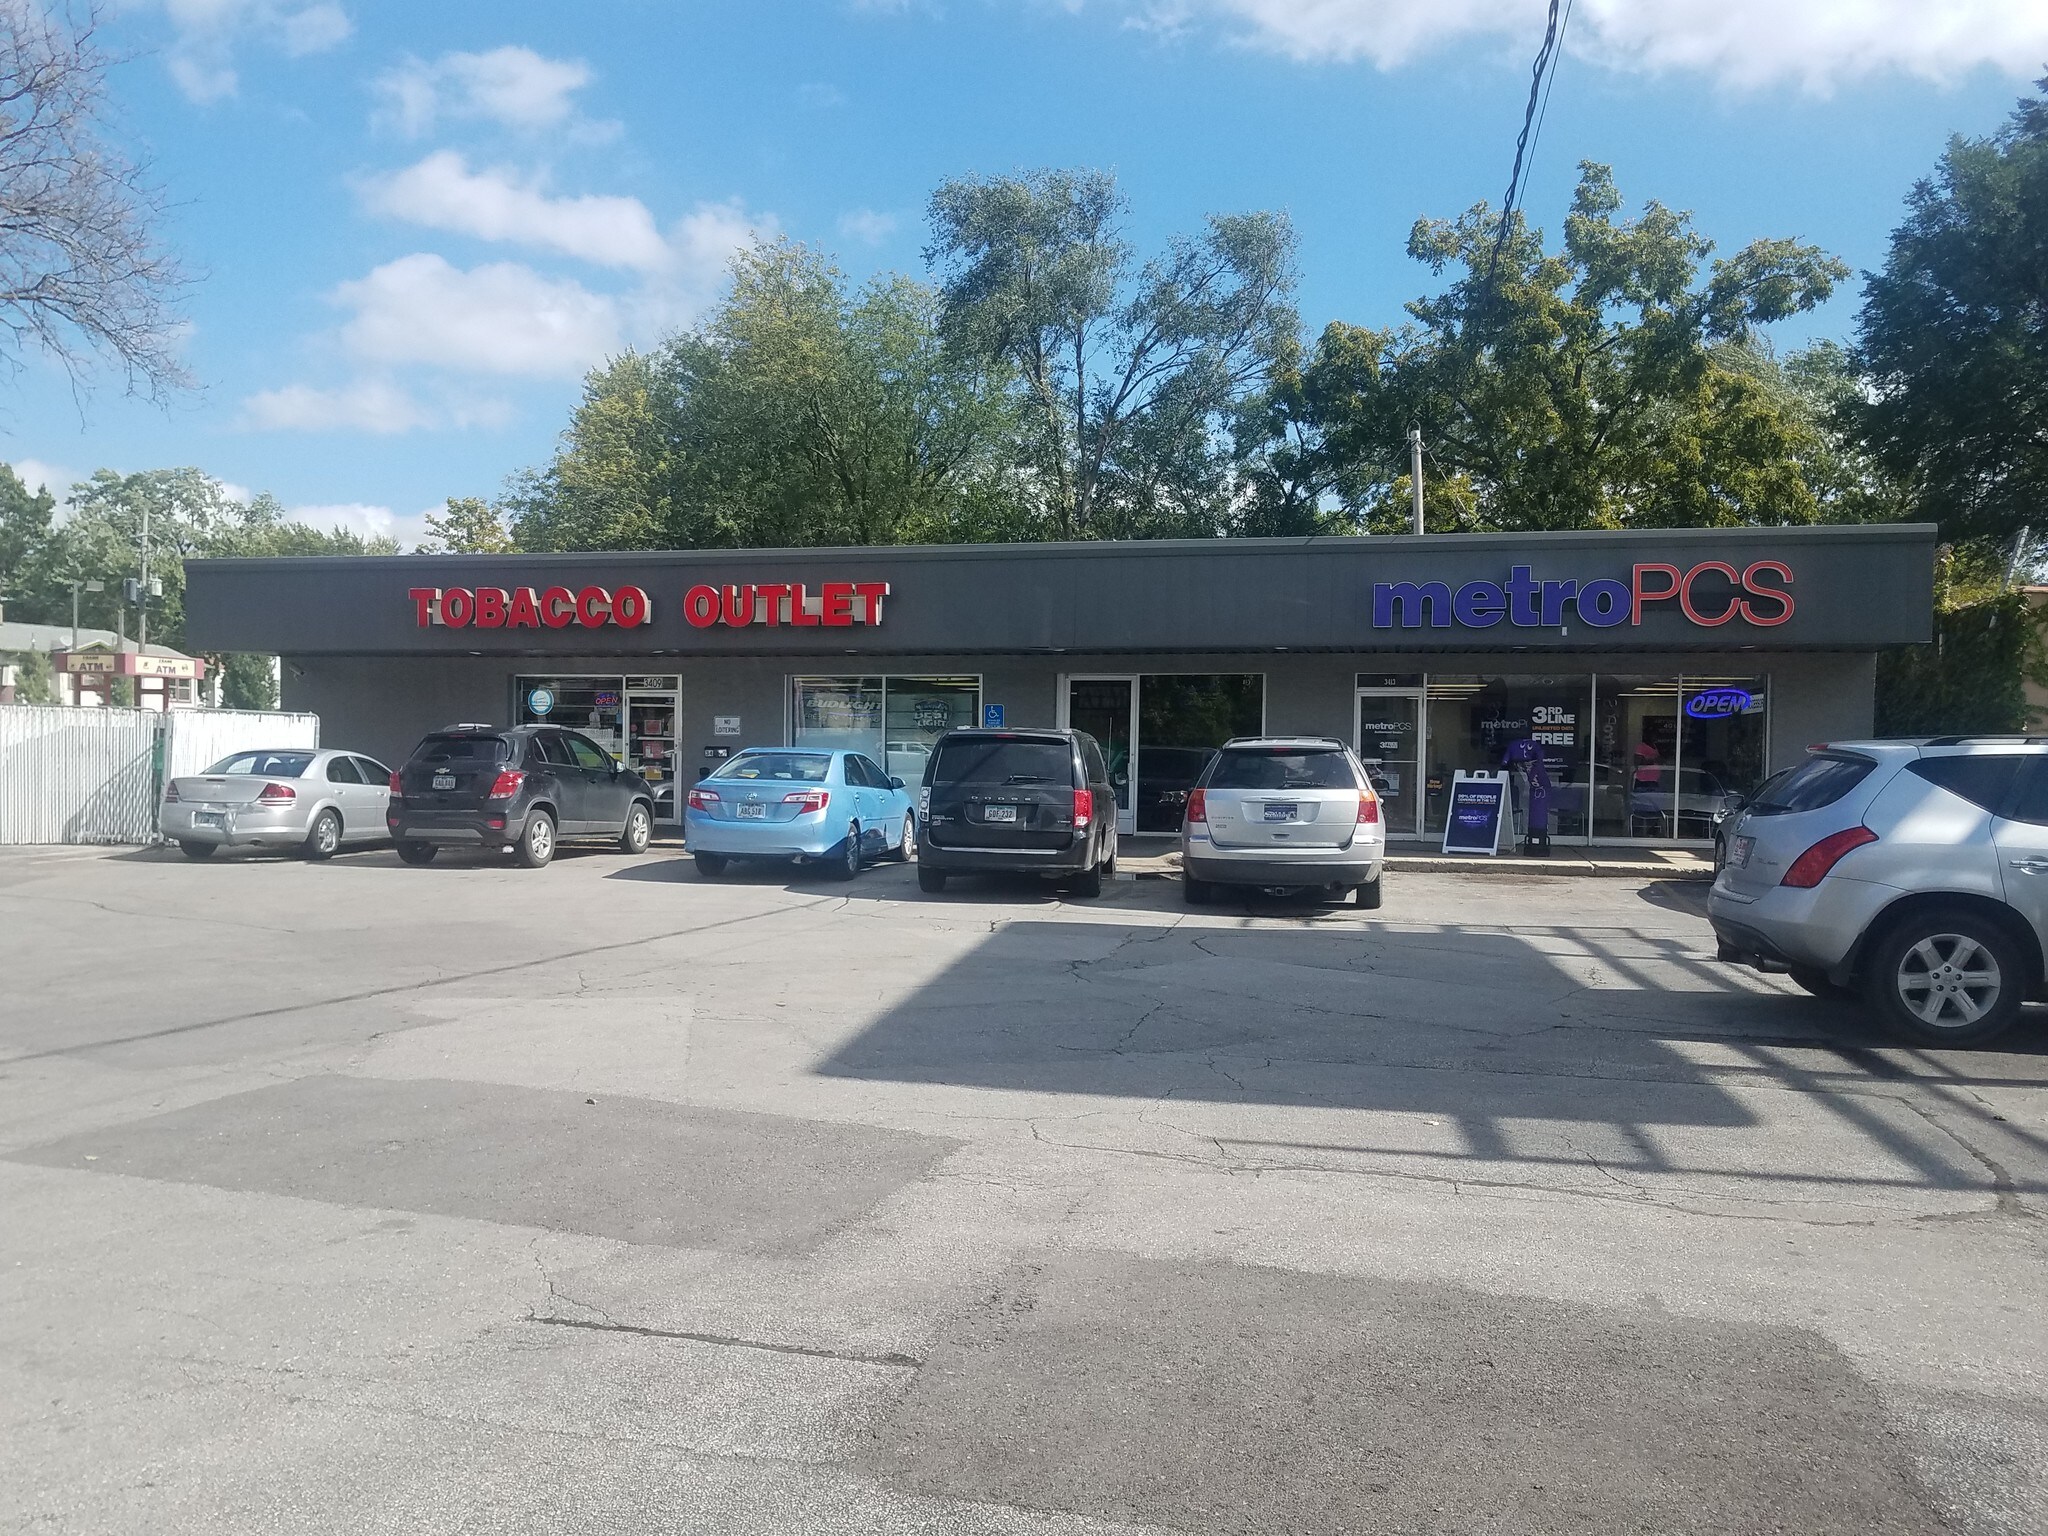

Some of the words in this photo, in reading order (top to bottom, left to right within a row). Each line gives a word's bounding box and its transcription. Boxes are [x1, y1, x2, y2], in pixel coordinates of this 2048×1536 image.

[1372, 560, 1795, 628] metroPCS
[408, 585, 651, 629] TOBACCO
[684, 582, 889, 628] OUTLET
[79, 662, 103, 671] ATM
[156, 665, 176, 674] ATM
[644, 678, 662, 688] 3409
[595, 697, 618, 705] OPEN
[1690, 695, 1746, 712] OPEN
[1548, 714, 1575, 723] LINE
[1365, 722, 1411, 731] metroPCS
[1532, 733, 1574, 745] FREE
